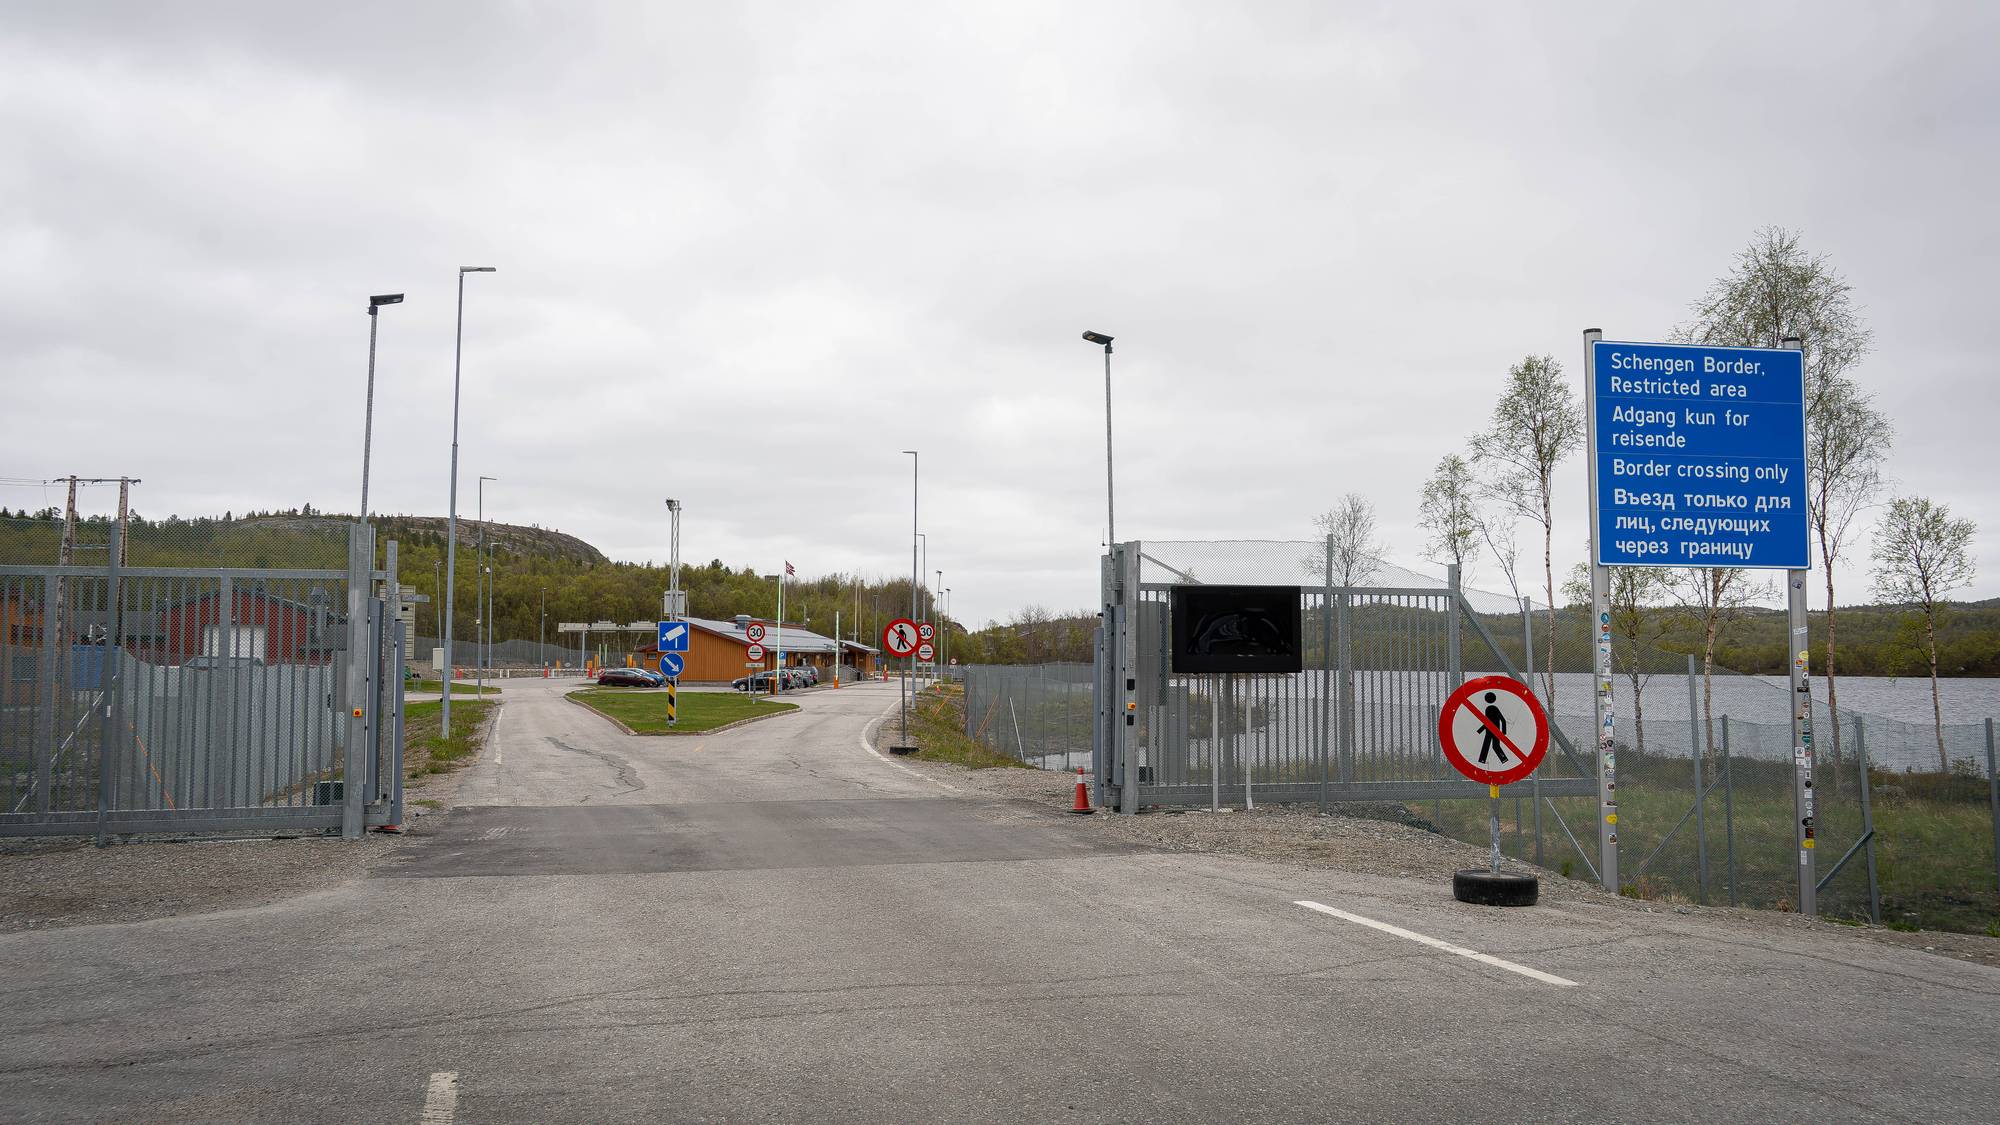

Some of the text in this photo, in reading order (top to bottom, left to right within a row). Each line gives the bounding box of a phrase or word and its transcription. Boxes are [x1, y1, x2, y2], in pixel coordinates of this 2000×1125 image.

[1611, 353, 1765, 376] Schengen Border,
[1611, 377, 1747, 397] Restricted area
[1613, 406, 1749, 427] Adgang kun for
[1613, 431, 1686, 448] reisende
[1613, 460, 1788, 483] Border crossing only
[1614, 489, 1791, 512] Въезд только для
[1615, 516, 1770, 535] лиц, следующих
[1615, 539, 1753, 559] через границу
[750, 628, 762, 637] 30
[920, 627, 932, 637] 30
